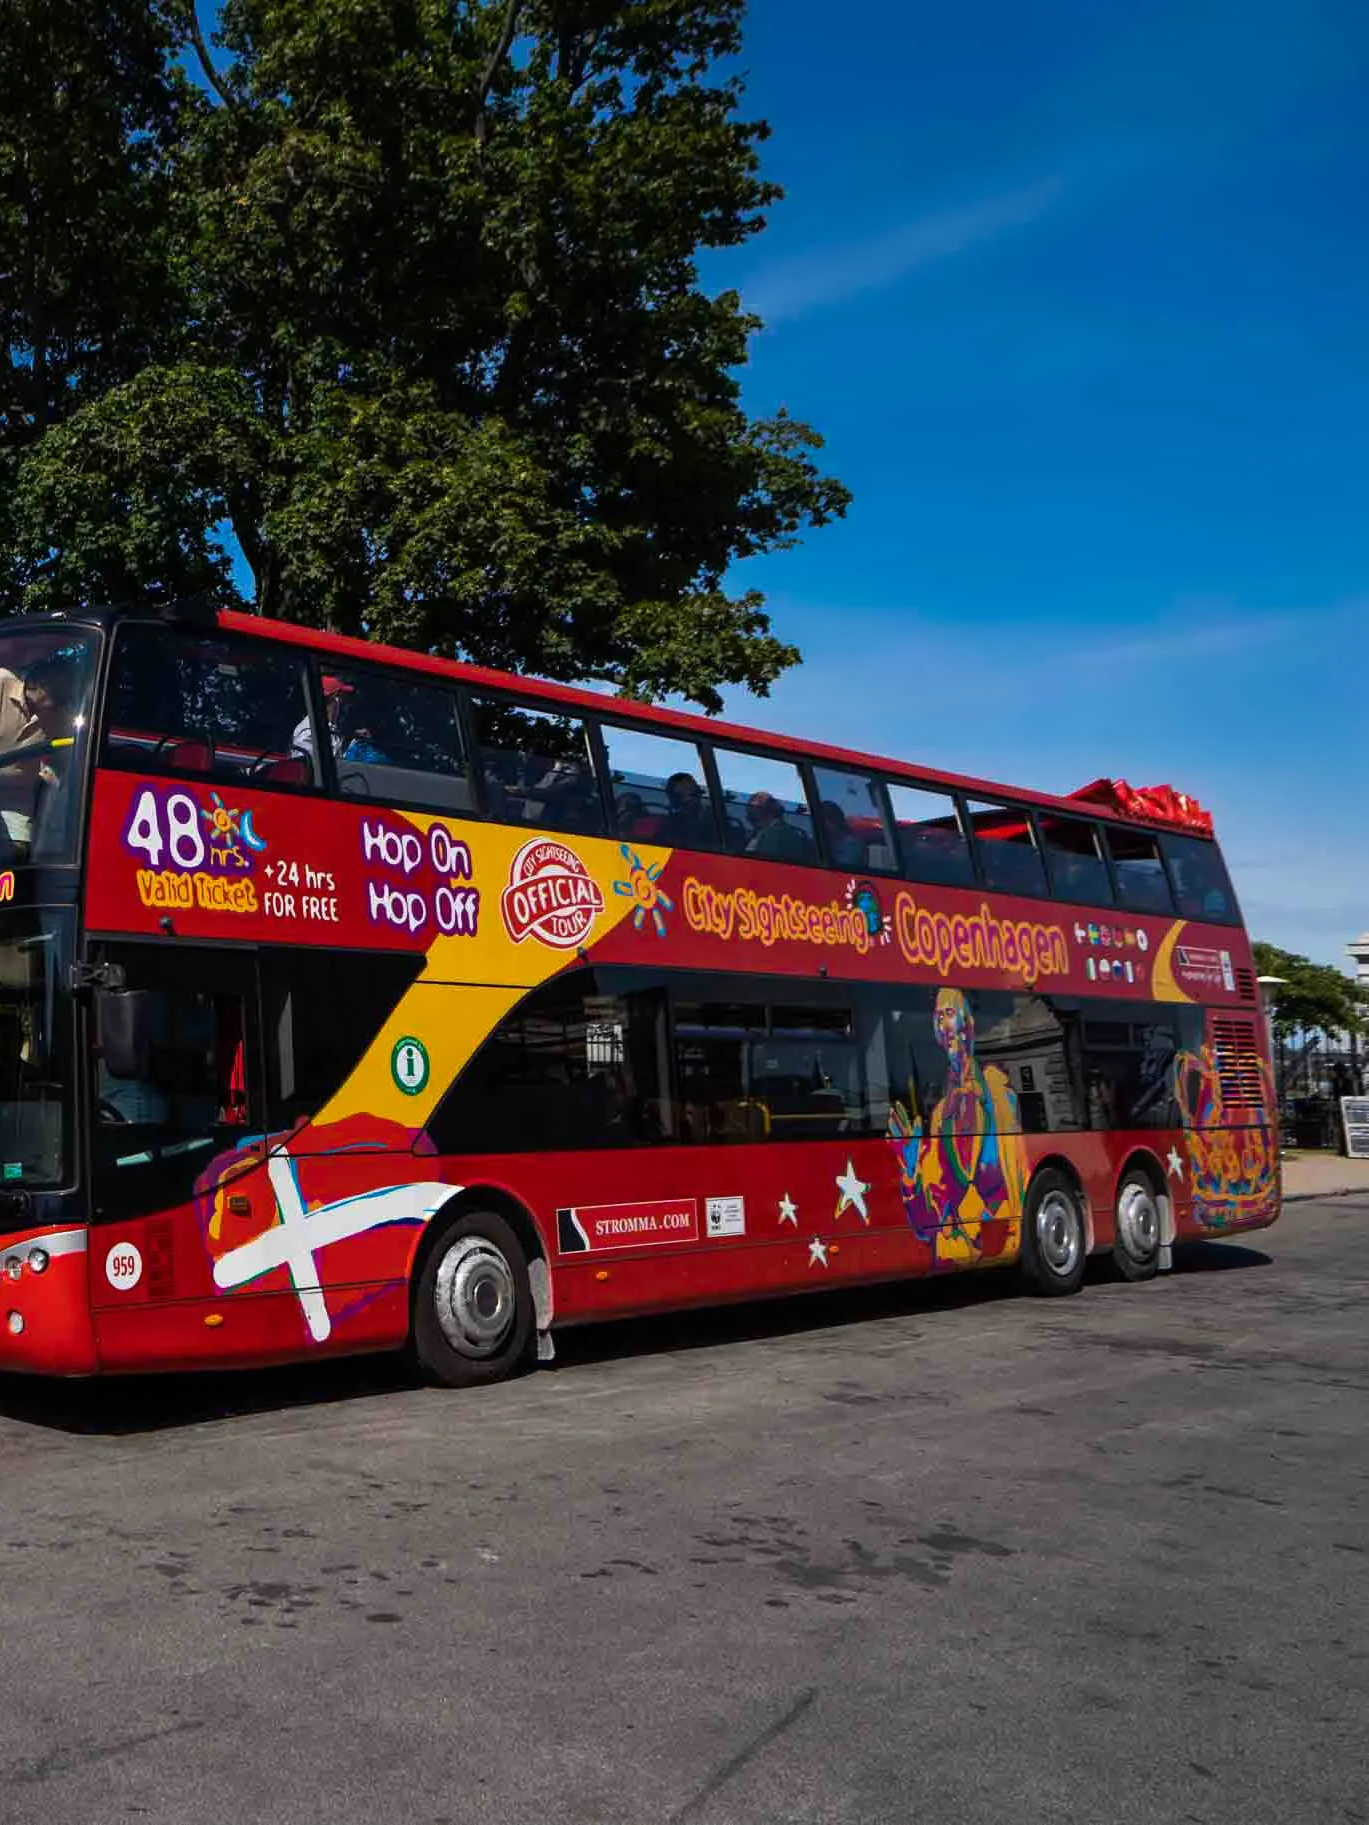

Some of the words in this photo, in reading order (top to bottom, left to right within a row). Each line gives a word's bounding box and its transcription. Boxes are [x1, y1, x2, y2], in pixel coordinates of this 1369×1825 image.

[128, 791, 205, 868] 48
[363, 821, 422, 873] Hop
[431, 828, 469, 874] On
[305, 864, 336, 891] hrs
[535, 846, 581, 874] SIGHTSEEING
[136, 868, 194, 909] Valid
[193, 872, 259, 913] Ticket
[264, 892, 297, 919] FOR
[302, 896, 340, 922] FREE
[369, 882, 427, 932] Hop
[435, 887, 477, 932] Off
[513, 879, 602, 924] OFFICIAL
[550, 910, 586, 937] TOUR
[894, 890, 1070, 983] Copenhagen
[112, 1255, 135, 1277] 959
